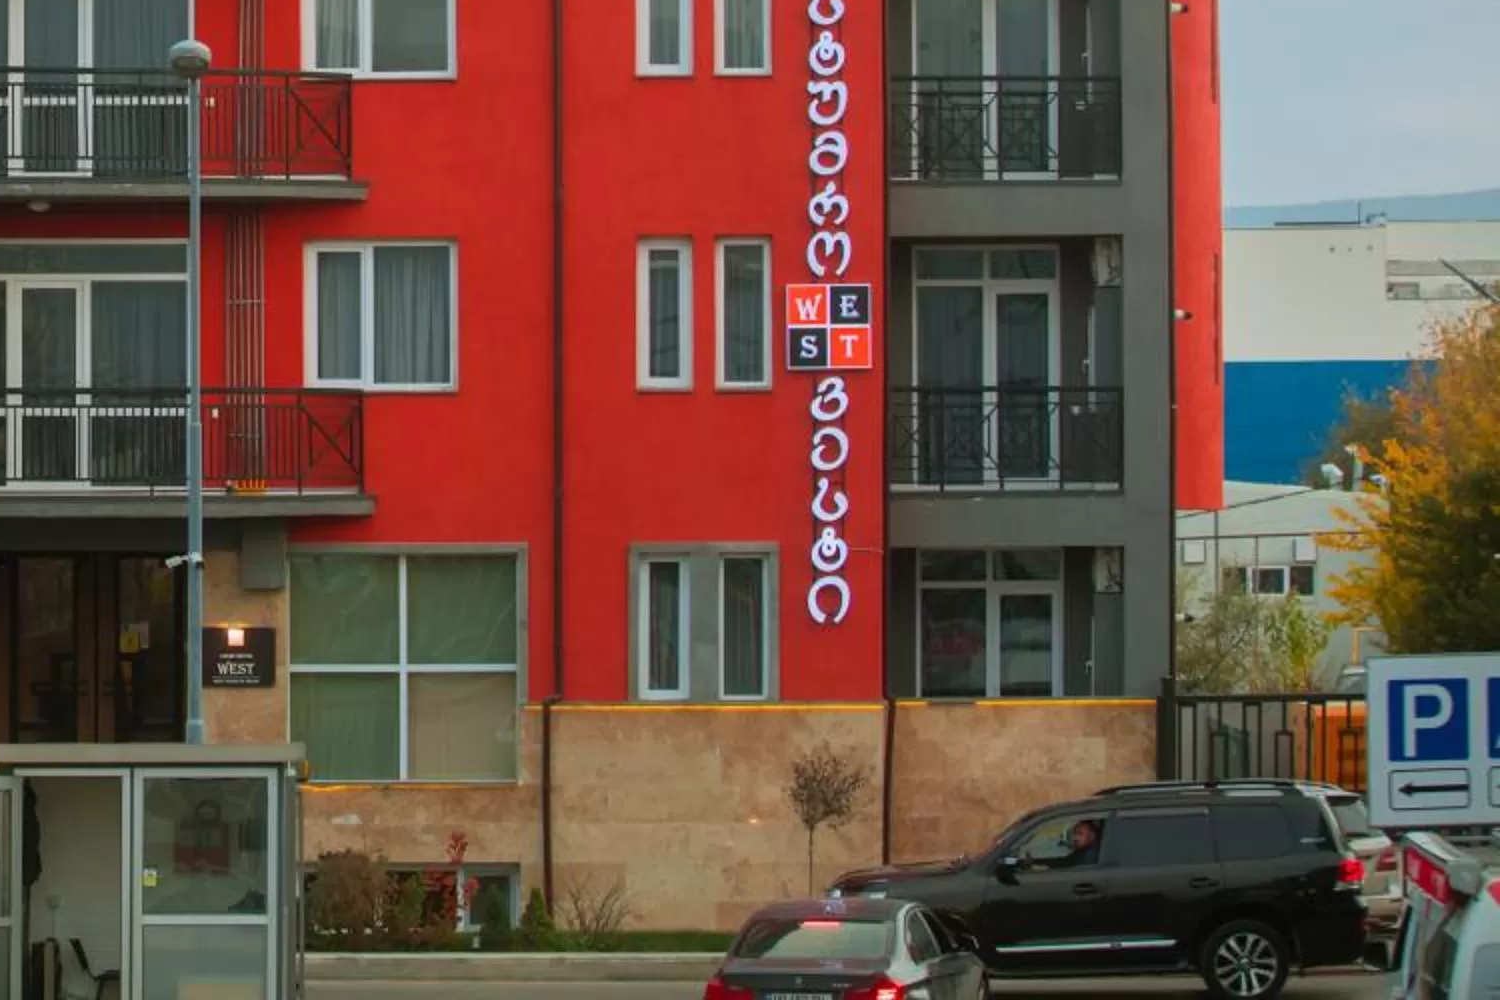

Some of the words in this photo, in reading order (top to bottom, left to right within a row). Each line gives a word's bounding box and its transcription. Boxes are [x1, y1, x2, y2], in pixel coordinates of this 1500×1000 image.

[807, 375, 852, 625] ვესტი
[216, 662, 255, 675] WEST
[1403, 683, 1453, 758] P
